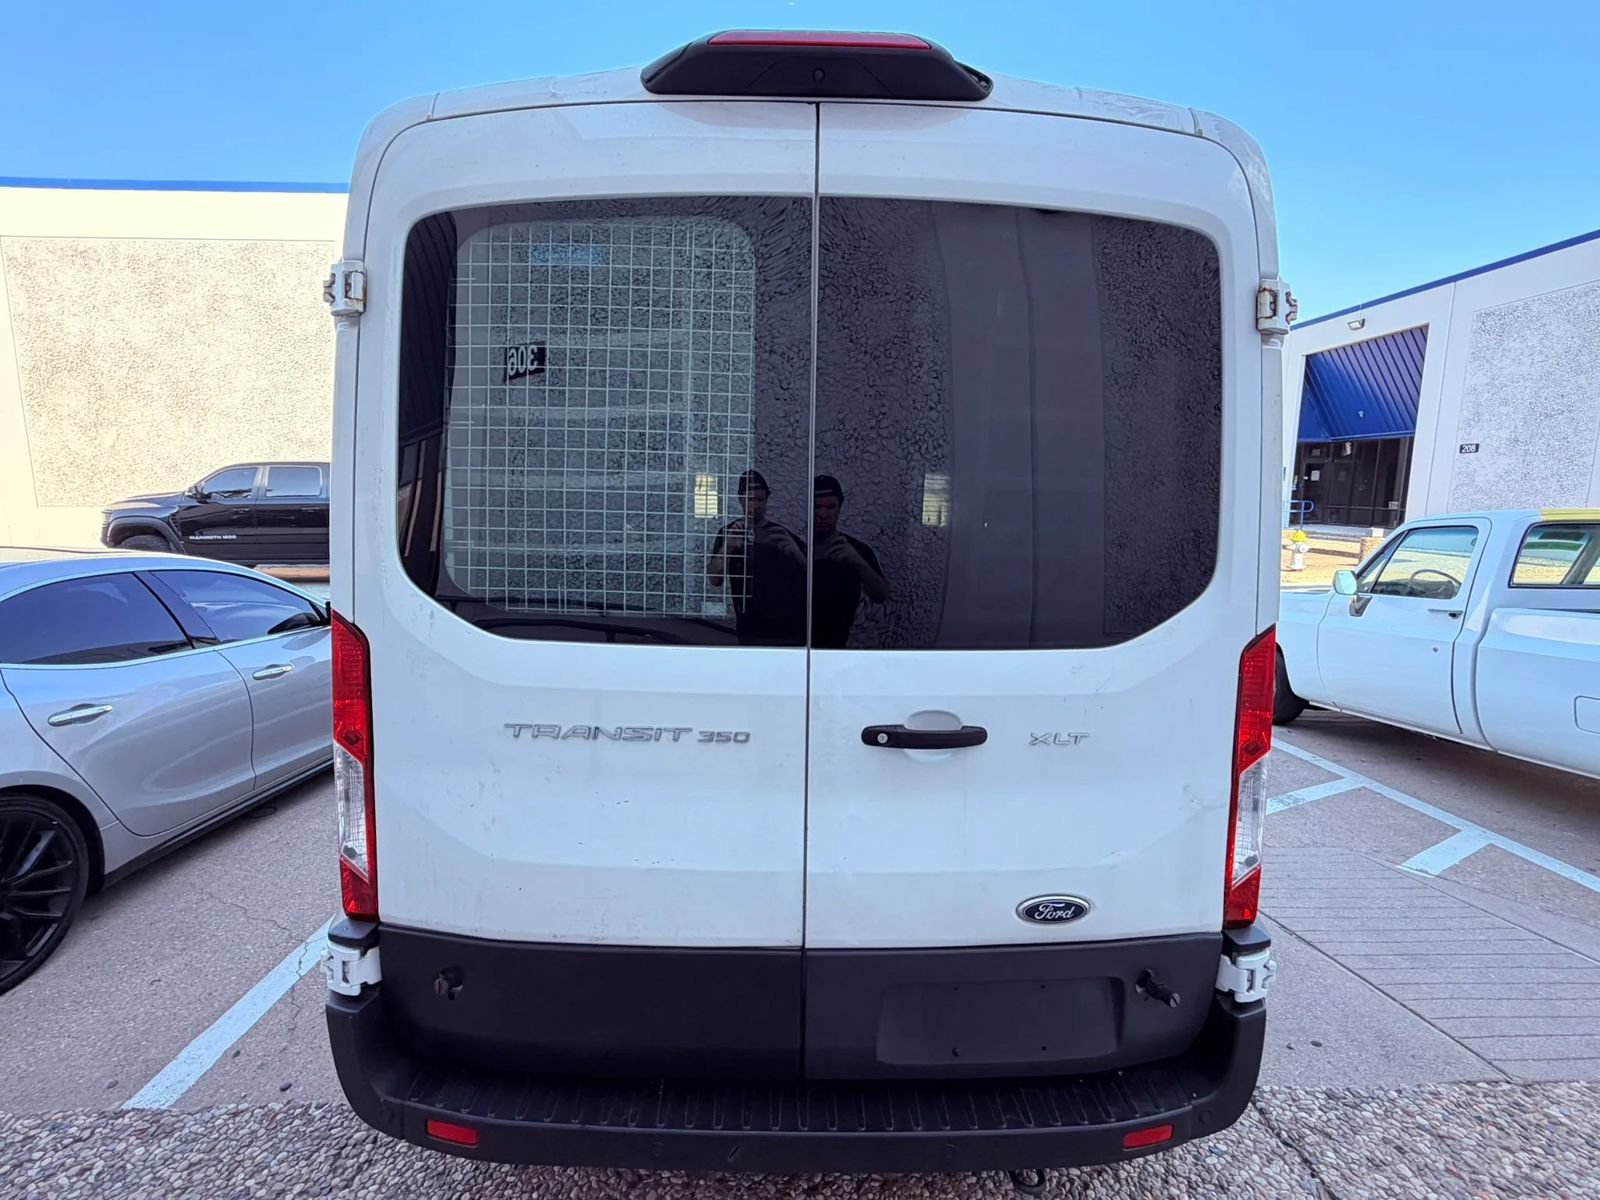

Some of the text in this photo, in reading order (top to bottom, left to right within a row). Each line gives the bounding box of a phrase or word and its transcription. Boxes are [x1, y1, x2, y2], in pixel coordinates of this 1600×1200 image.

[503, 723, 750, 744] TRANSIT 350
[1028, 732, 1089, 746] XLT
[1034, 903, 1076, 919] Ford
